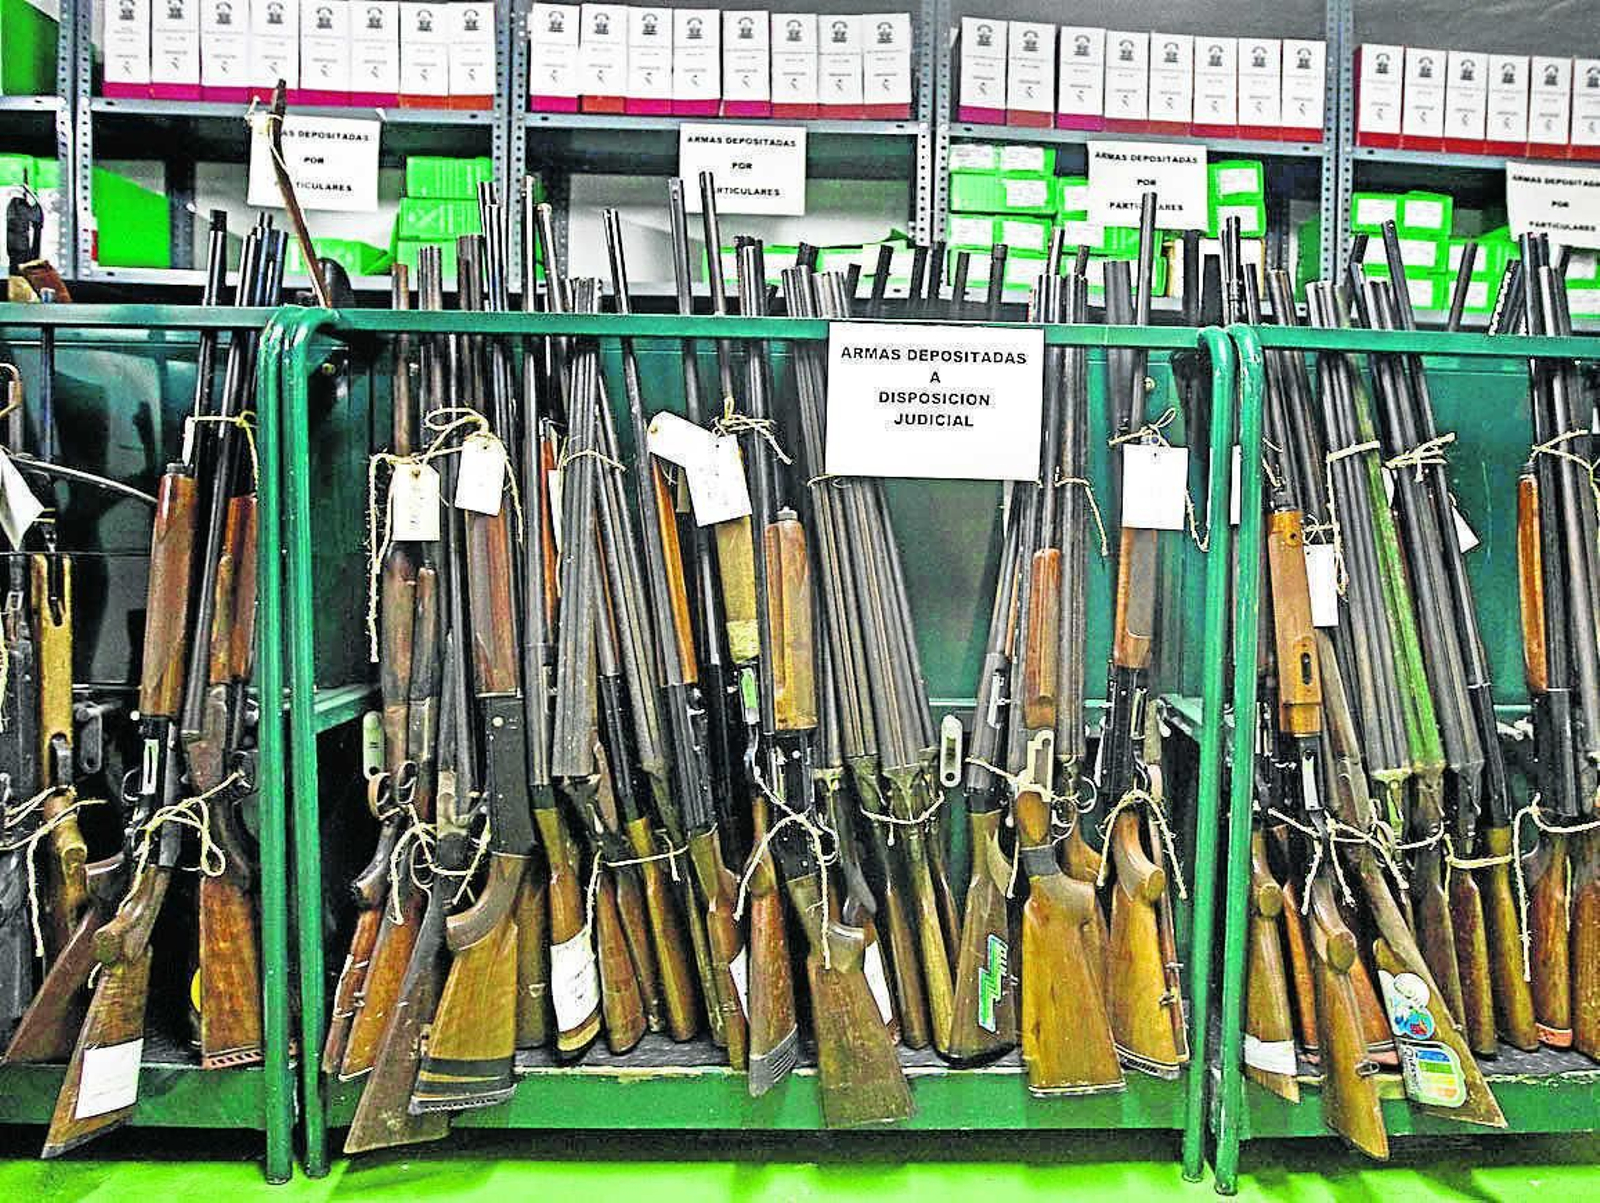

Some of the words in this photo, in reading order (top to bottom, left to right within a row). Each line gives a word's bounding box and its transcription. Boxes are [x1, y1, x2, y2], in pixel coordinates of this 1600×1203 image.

[298, 130, 369, 141] DEPOSITADAS
[688, 136, 722, 144] ARMAS
[725, 137, 797, 147] DEPOSITADAS
[303, 156, 325, 164] POR
[1095, 151, 1127, 161] ARMAS
[1130, 154, 1198, 164] DEPOSITADAS
[731, 162, 753, 170] POR
[1512, 175, 1542, 183] ARMAS
[717, 187, 780, 196] RTICULARES
[1552, 200, 1569, 208] POR
[1528, 221, 1597, 232] PARTICULARES
[841, 346, 901, 361] ARMAS
[907, 349, 1027, 365] DEPOSITADAS
[929, 371, 941, 383] A
[878, 391, 990, 406] DISPOSICION
[894, 413, 974, 427] JUDICIAL
